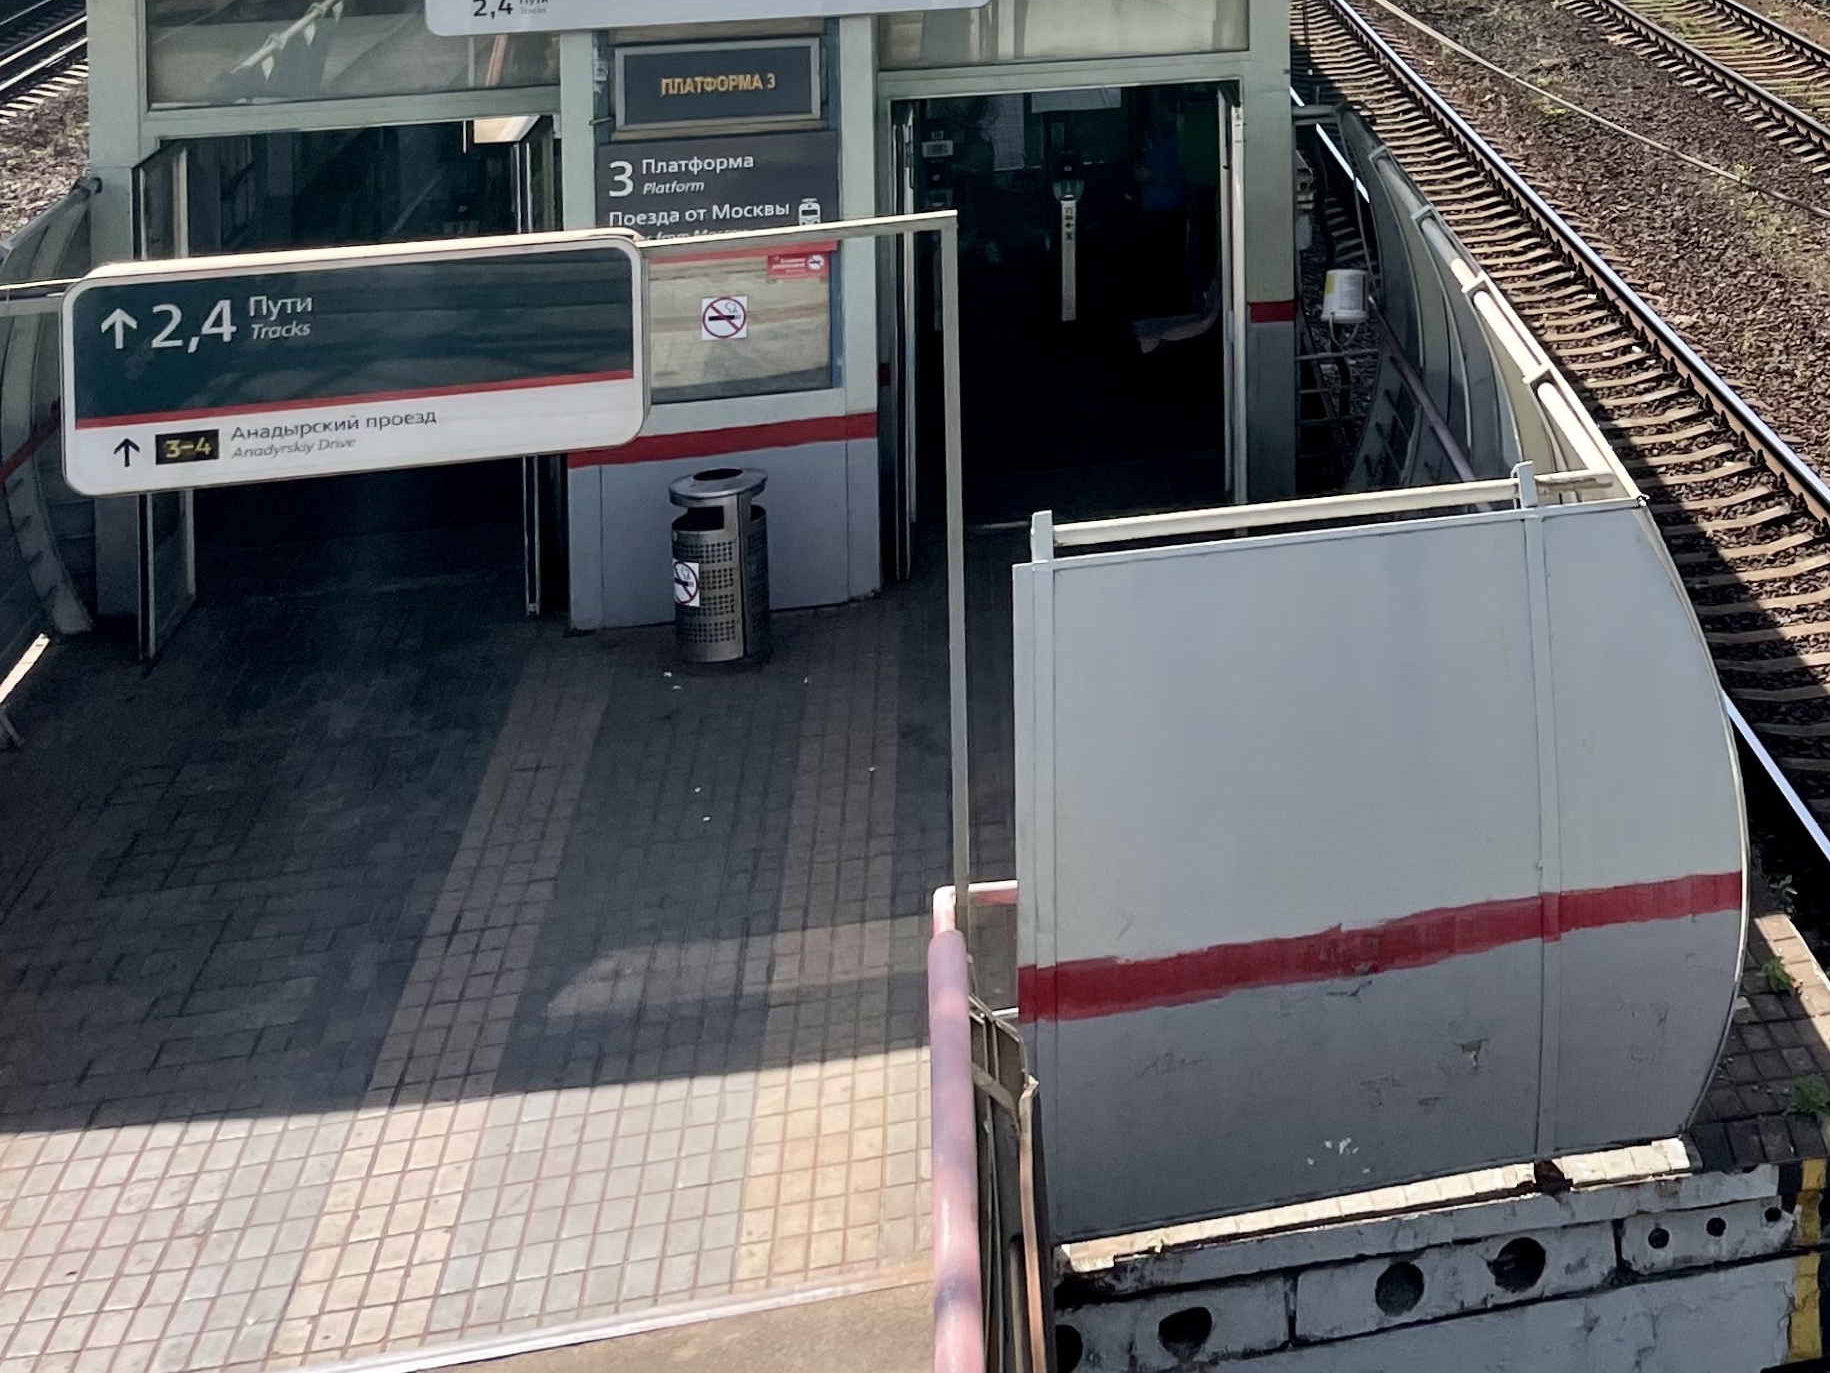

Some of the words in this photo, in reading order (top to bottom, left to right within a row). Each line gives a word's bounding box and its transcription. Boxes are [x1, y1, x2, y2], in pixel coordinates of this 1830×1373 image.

[661, 74, 763, 97] ПЛАТФОРМА
[767, 73, 776, 89] 3
[642, 155, 754, 175] Платформа
[609, 160, 634, 198] 3
[642, 180, 705, 195] Platform
[609, 210, 680, 227] Поезда
[685, 208, 707, 222] от
[712, 202, 790, 220] Москвы
[249, 295, 313, 321] Пути
[151, 299, 237, 353] 2,4
[251, 321, 311, 340] Tracks
[231, 414, 359, 441] Анадырский
[366, 411, 437, 432] проезд
[231, 439, 315, 459] Anadyrskiy
[318, 437, 356, 451] Drive
